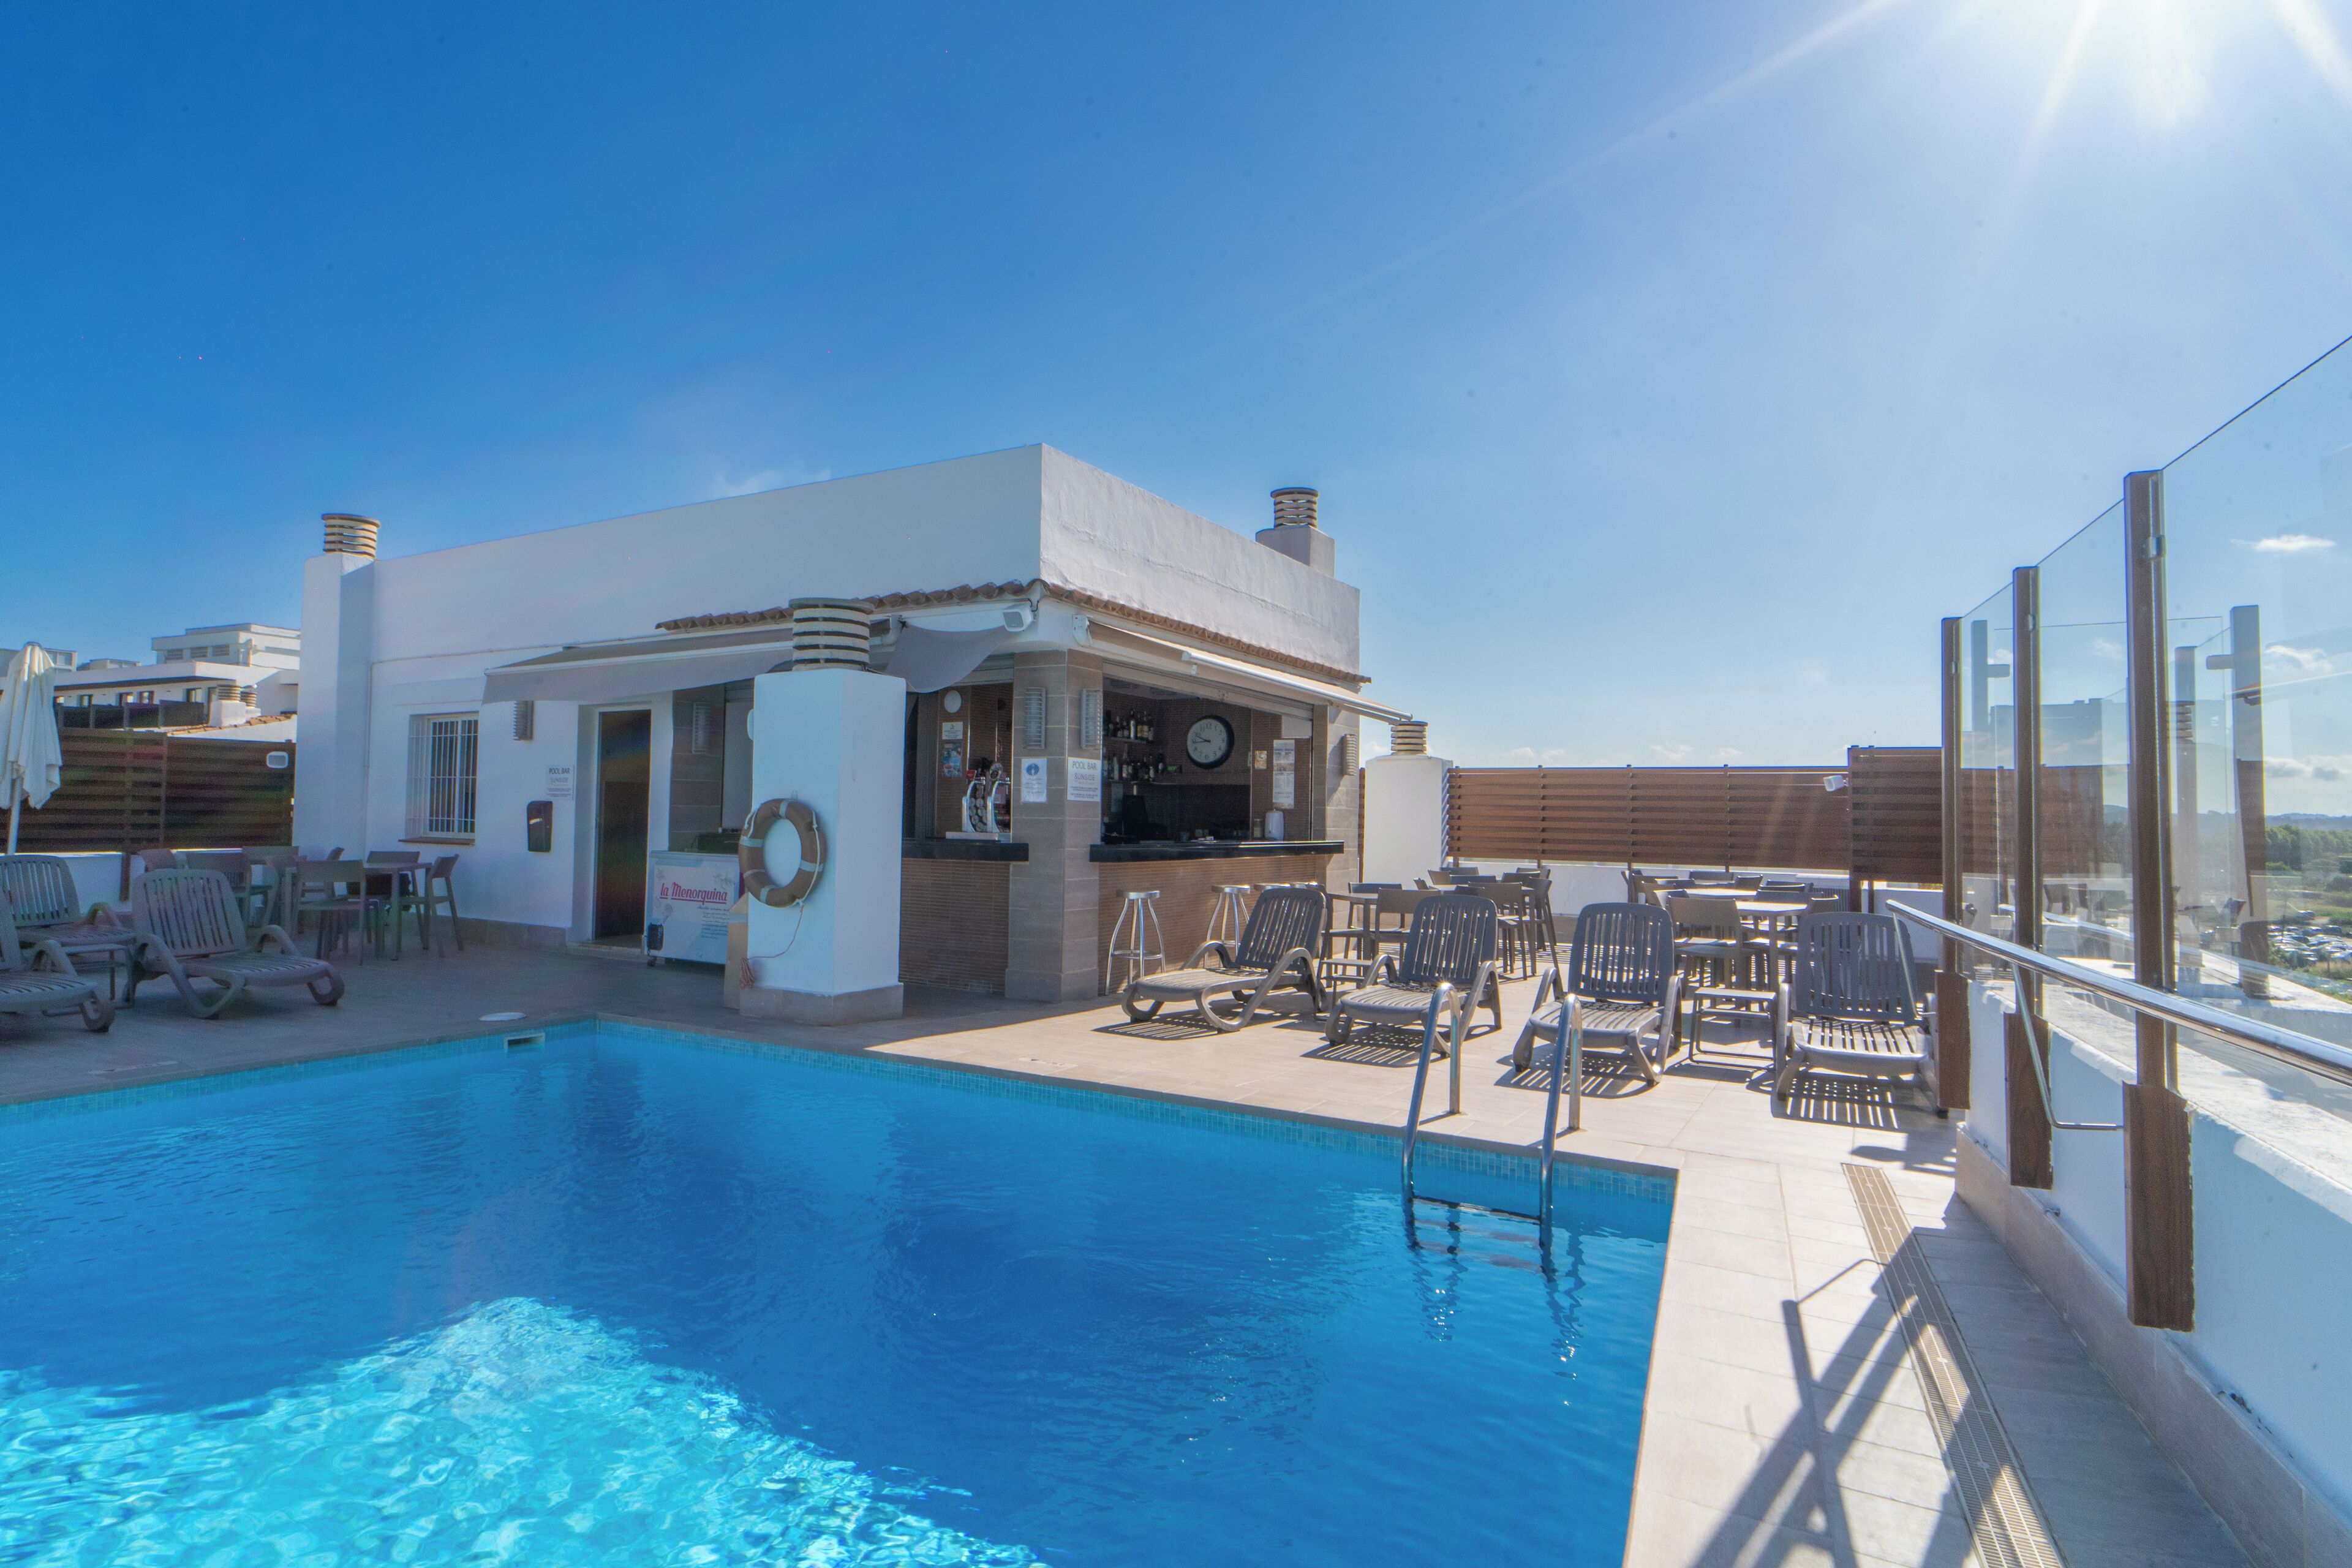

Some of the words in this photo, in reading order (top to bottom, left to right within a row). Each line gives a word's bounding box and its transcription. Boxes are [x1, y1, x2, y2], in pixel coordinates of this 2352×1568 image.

[1072, 761, 1086, 770] POOL
[1087, 762, 1097, 771] BAR
[660, 883, 669, 897] la
[671, 882, 727, 905] Menorquina
